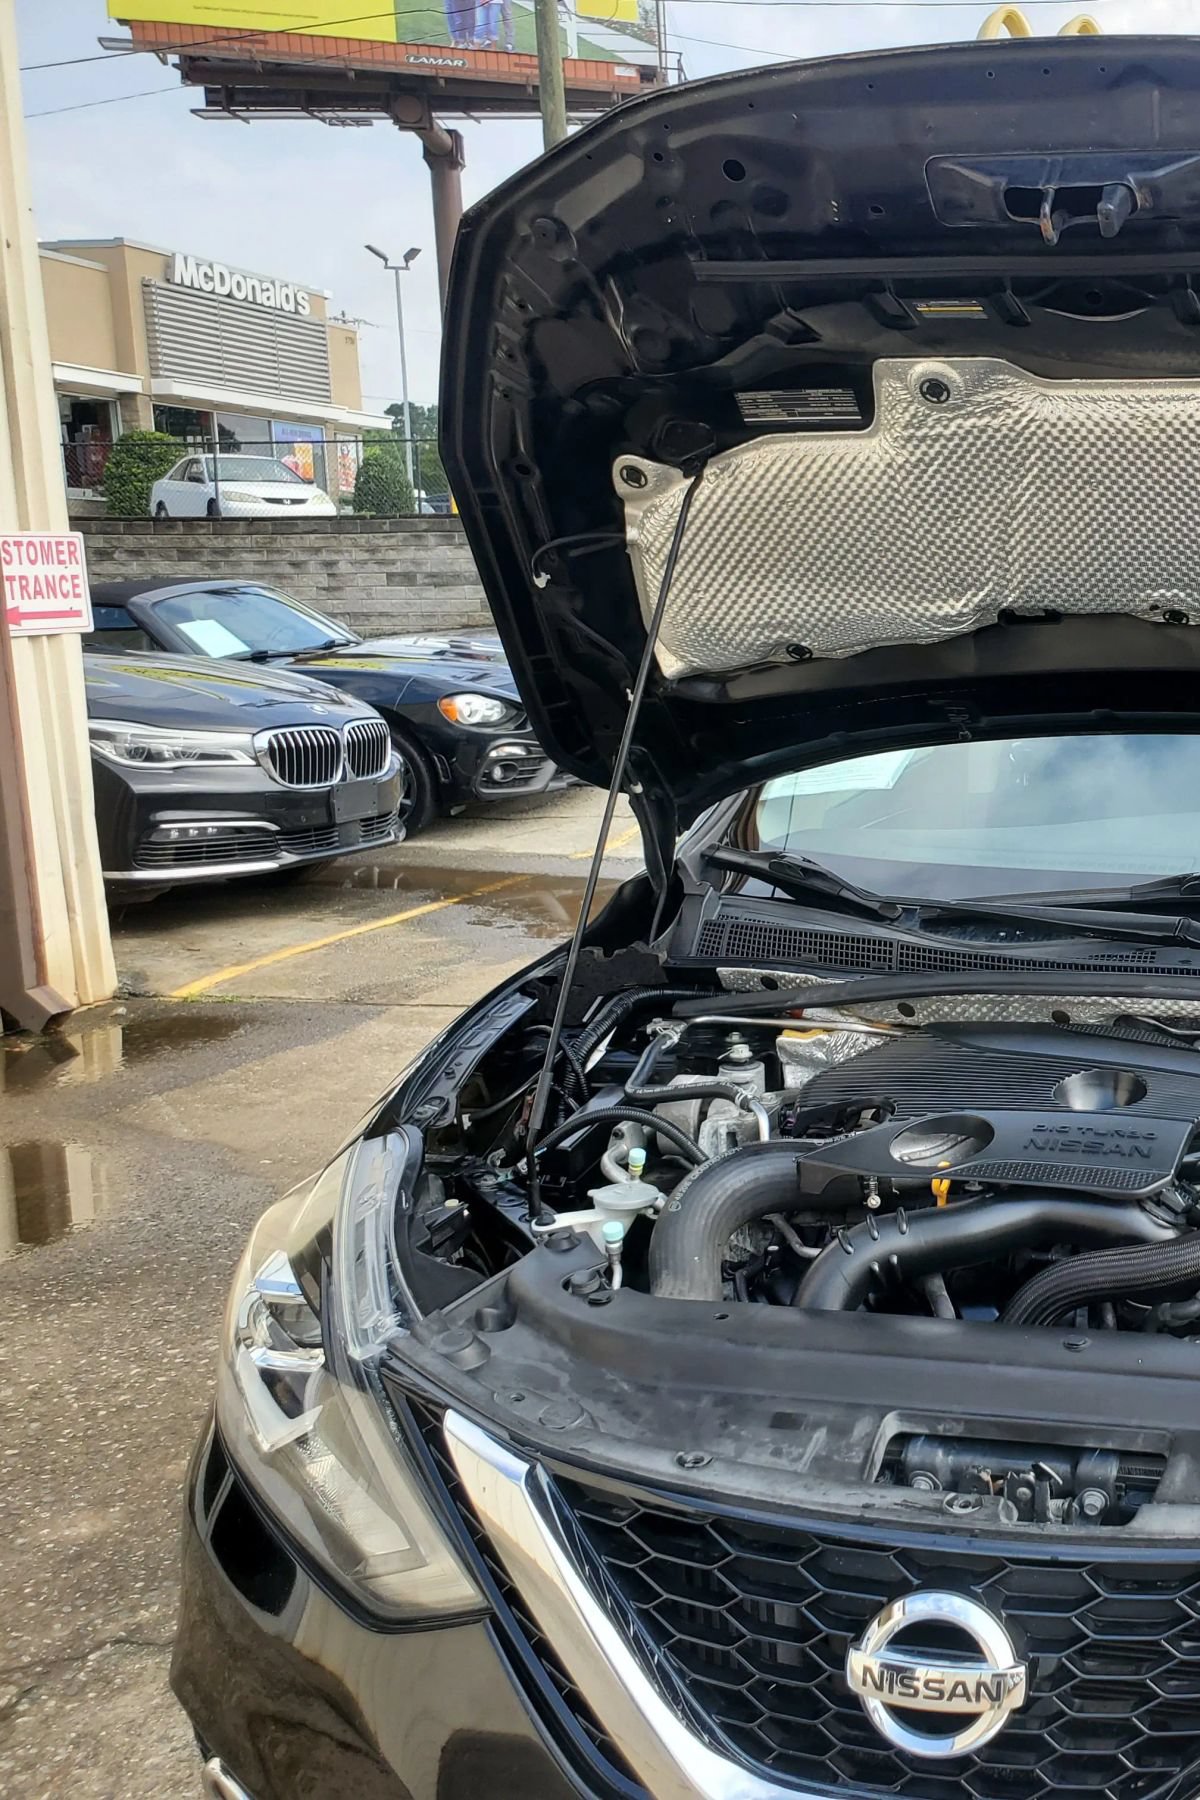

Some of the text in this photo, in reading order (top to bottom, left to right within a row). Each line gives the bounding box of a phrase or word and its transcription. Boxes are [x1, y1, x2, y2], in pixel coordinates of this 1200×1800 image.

[408, 56, 464, 66] LAMAR
[174, 252, 310, 315] McDonald's
[1023, 1137, 1153, 1159] NISSAN
[861, 1665, 1004, 1703] NISSAN
